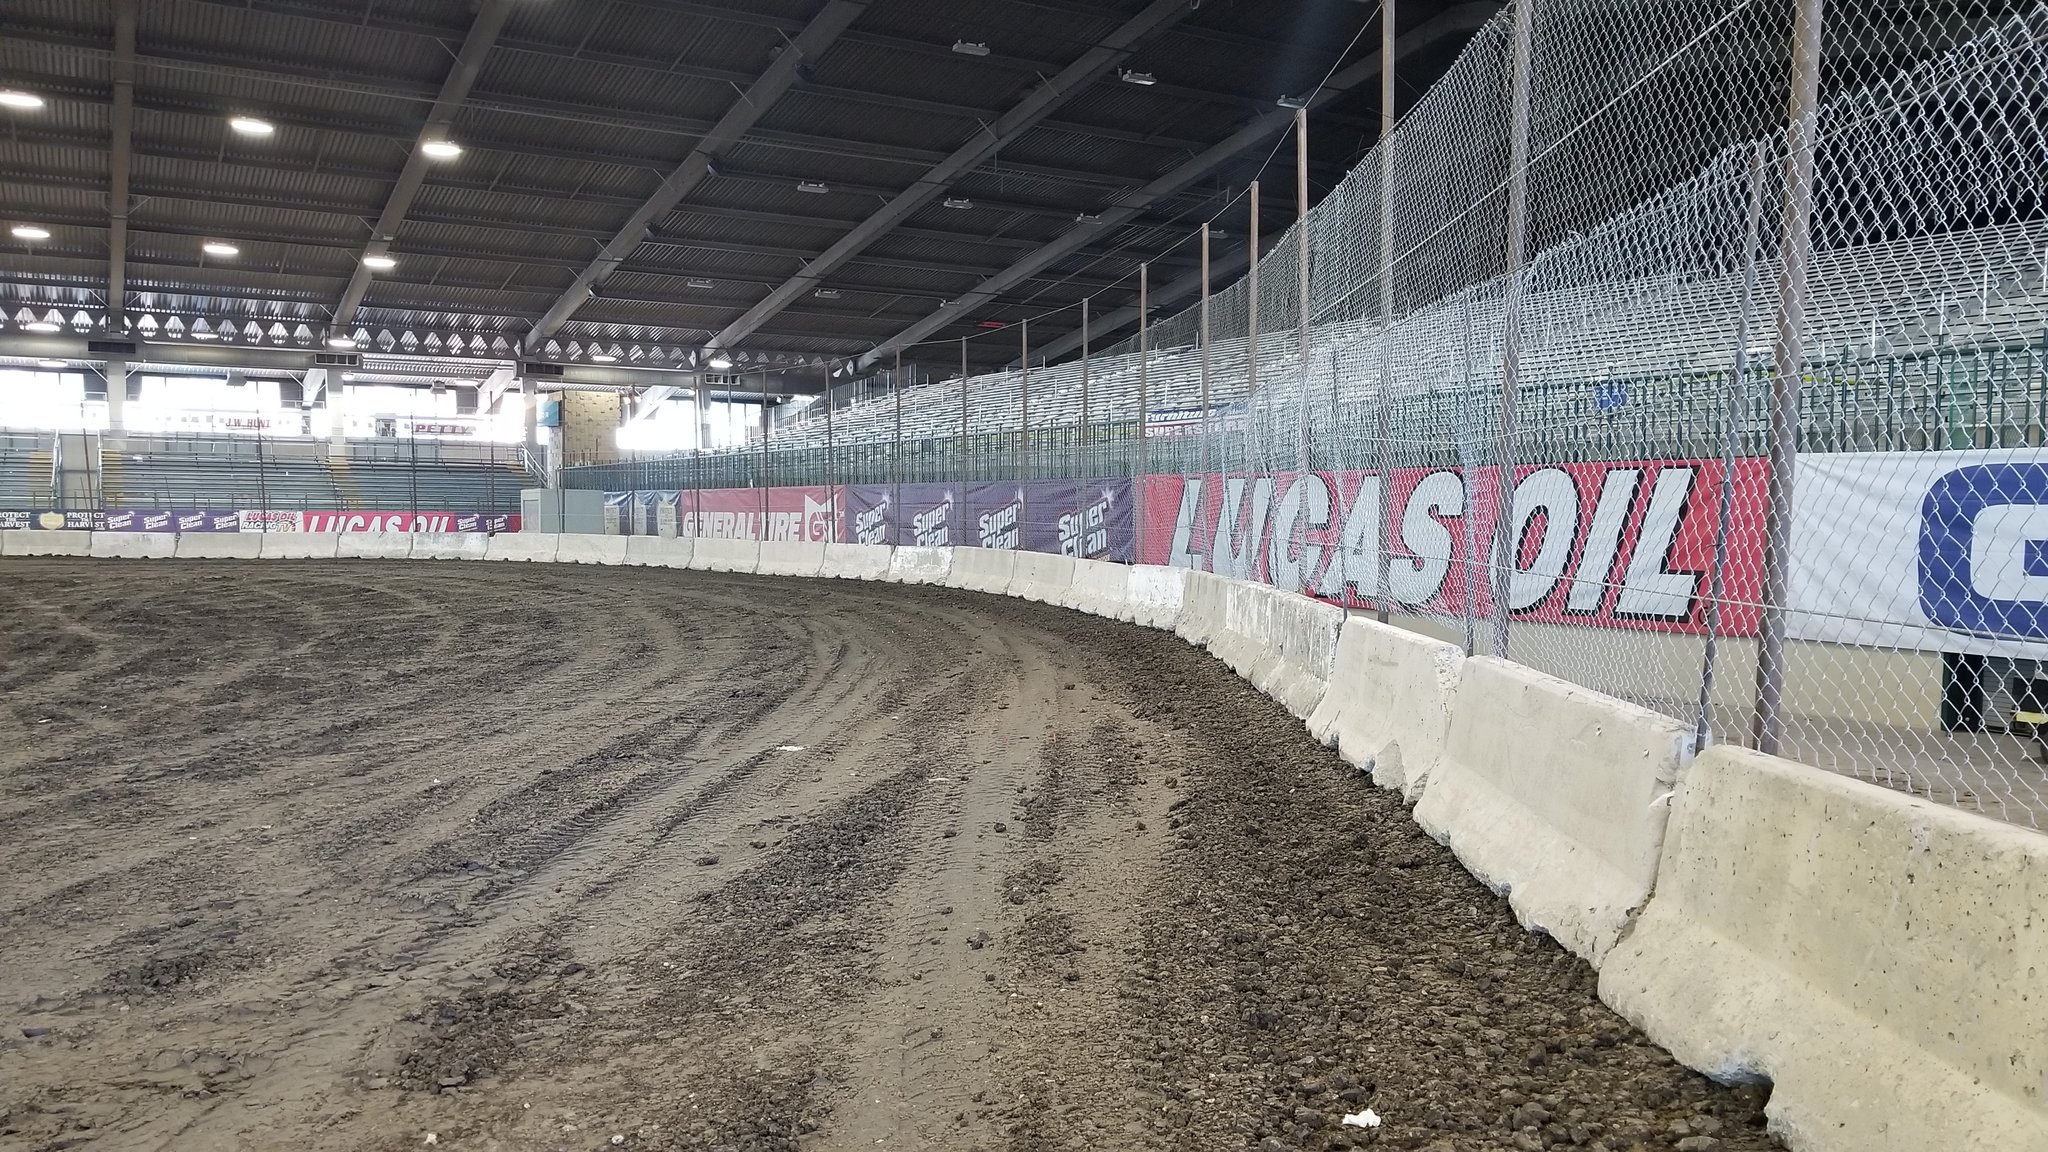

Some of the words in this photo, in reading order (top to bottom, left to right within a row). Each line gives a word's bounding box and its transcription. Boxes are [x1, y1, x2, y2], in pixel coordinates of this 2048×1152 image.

[107, 514, 132, 523] Super
[144, 515, 167, 524] Super
[179, 515, 202, 524] Super
[214, 516, 237, 524] Super
[246, 512, 279, 521] LUCAS
[280, 511, 296, 521] OIL
[856, 502, 886, 534] Super
[913, 503, 950, 537] Super
[979, 502, 1020, 539] Super
[109, 519, 132, 530] Clean
[145, 520, 168, 530] Clean
[180, 520, 203, 530] Clean
[215, 521, 238, 530] Clean
[241, 521, 276, 529] RACING
[275, 522, 292, 532] TV
[308, 516, 402, 533] LUCAS
[408, 515, 450, 533] OIL
[683, 511, 758, 541] GENERAL
[858, 524, 886, 546] Clean
[917, 526, 950, 547] Clean
[981, 527, 1019, 551] Clean
[1169, 470, 1466, 605] LUCAS
[1490, 467, 1698, 618] OIL
